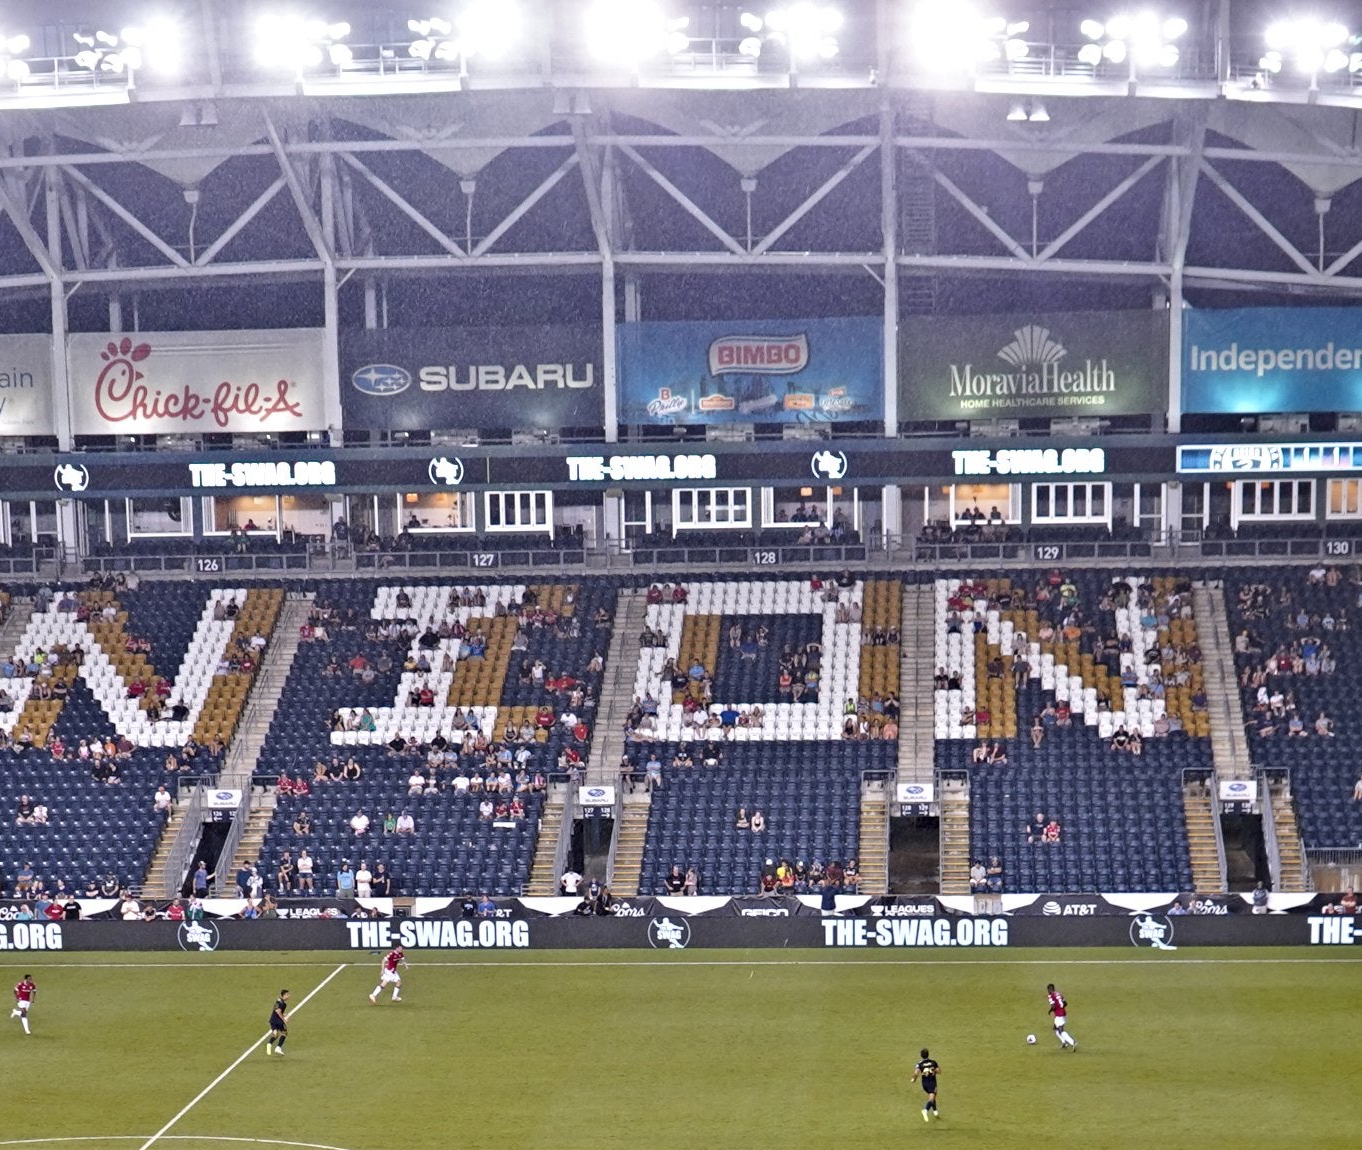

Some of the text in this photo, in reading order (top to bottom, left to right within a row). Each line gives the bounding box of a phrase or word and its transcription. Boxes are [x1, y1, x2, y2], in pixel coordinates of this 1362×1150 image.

[718, 344, 801, 366] BIMBO
[419, 363, 594, 392] SUBARU
[949, 359, 1116, 397] MoraviaHealth
[94, 358, 303, 427] Chick-fil-A
[960, 395, 1105, 409] HOME HEALTHCARE SERVICES
[1037, 546, 1059, 559] 129
[1327, 541, 1349, 555] 130
[473, 554, 494, 567] 127
[755, 552, 776, 564] 128
[197, 559, 218, 571] 126
[884, 904, 934, 914] LEAGUES
[1063, 904, 1097, 915] AT&T
[346, 921, 529, 947] THE-SWAG.ORG
[656, 929, 681, 940] SWAG
[821, 919, 1008, 946] THE-SWAG.ORG
[1139, 928, 1164, 939] SWAG
